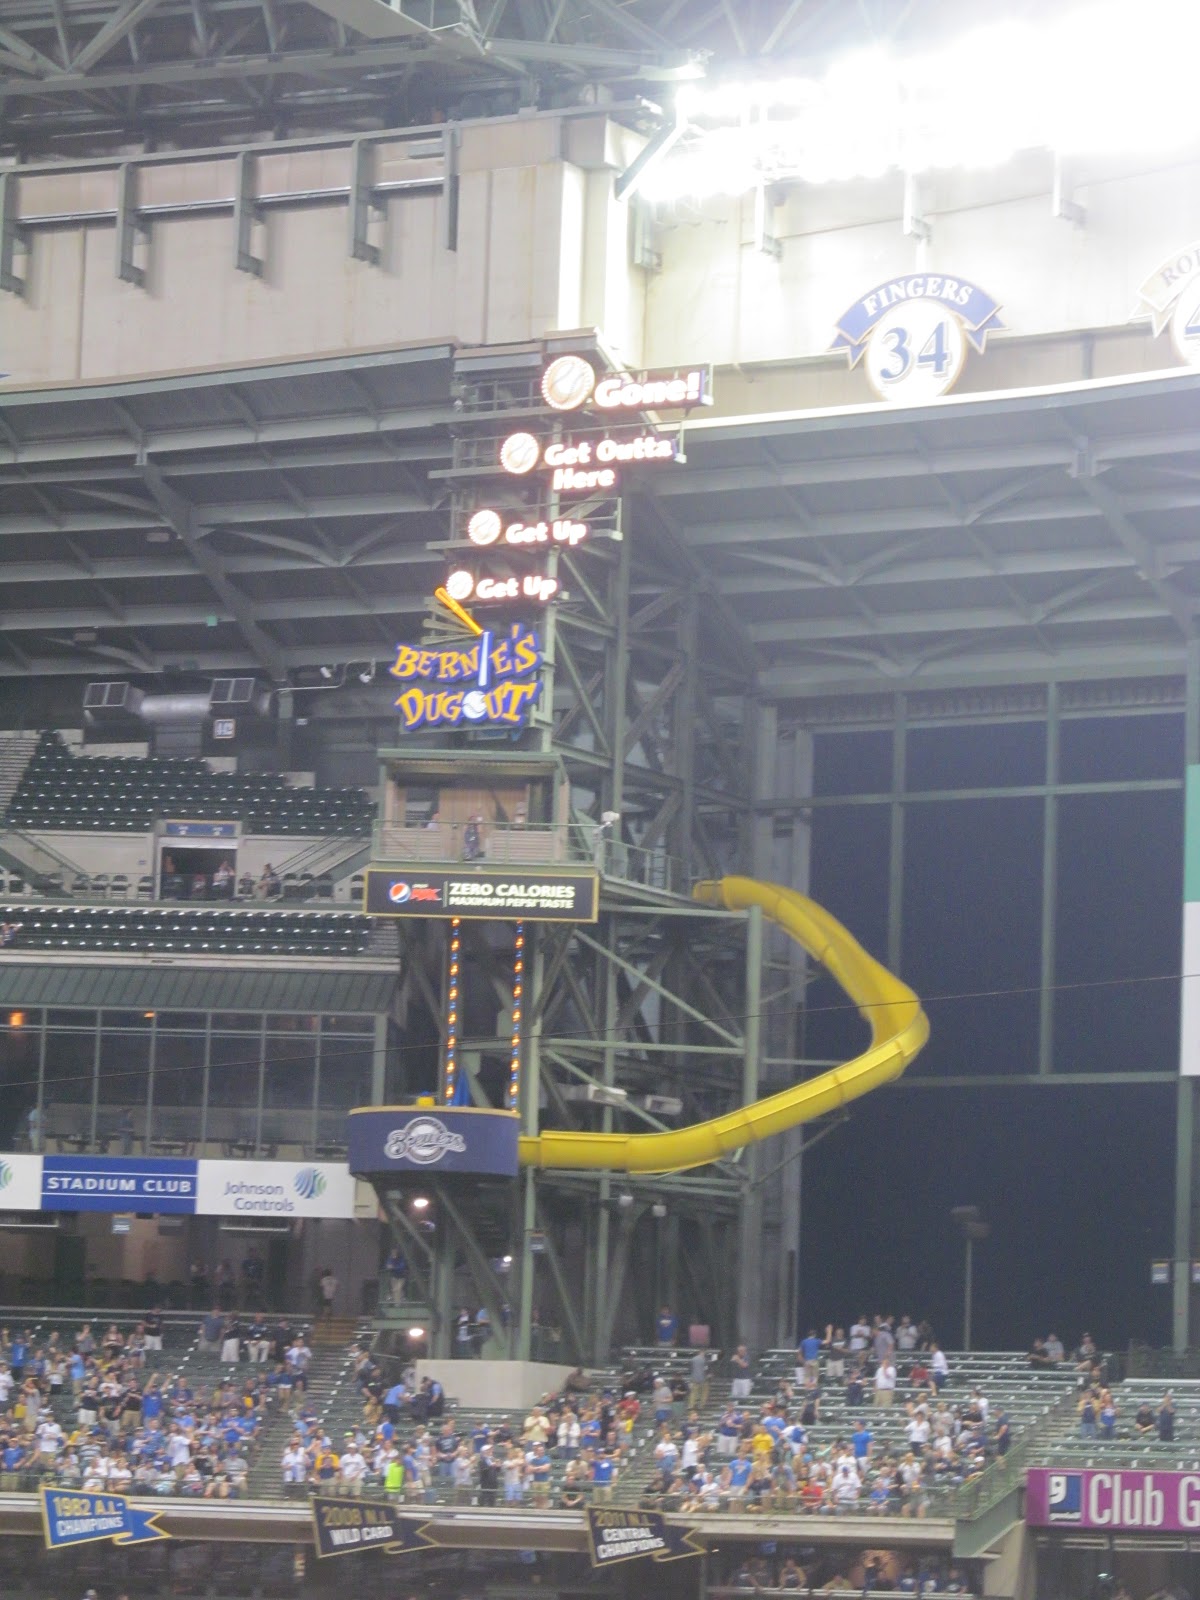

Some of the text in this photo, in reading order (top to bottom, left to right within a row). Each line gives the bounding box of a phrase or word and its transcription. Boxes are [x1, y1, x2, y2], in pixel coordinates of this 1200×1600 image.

[861, 277, 974, 317] FINGERS
[880, 321, 948, 381] 34
[594, 372, 701, 408] Gone!
[544, 437, 672, 466] Get Outta
[553, 468, 615, 491] Here
[506, 520, 587, 546] Get Up
[475, 576, 558, 601] Get Up
[395, 681, 537, 726] DUGOUT
[449, 882, 494, 896] ZERO
[495, 884, 576, 898] CALORIES
[448, 896, 506, 907] MAXIMUM
[538, 899, 575, 909] TASTE
[384, 1129, 467, 1160] Brewers
[47, 1177, 192, 1193] STADIUM CLUB
[224, 1181, 284, 1197] Johnson
[233, 1198, 295, 1212] Controls
[53, 1497, 93, 1517] 1982
[1089, 1473, 1165, 1527] Club
[56, 1517, 124, 1537] CHAMPIONS
[322, 1505, 363, 1527] 2008
[329, 1526, 393, 1546] WILD CARD
[602, 1528, 654, 1543] CENTRAL
[597, 1537, 665, 1559] CHAMPIONS
